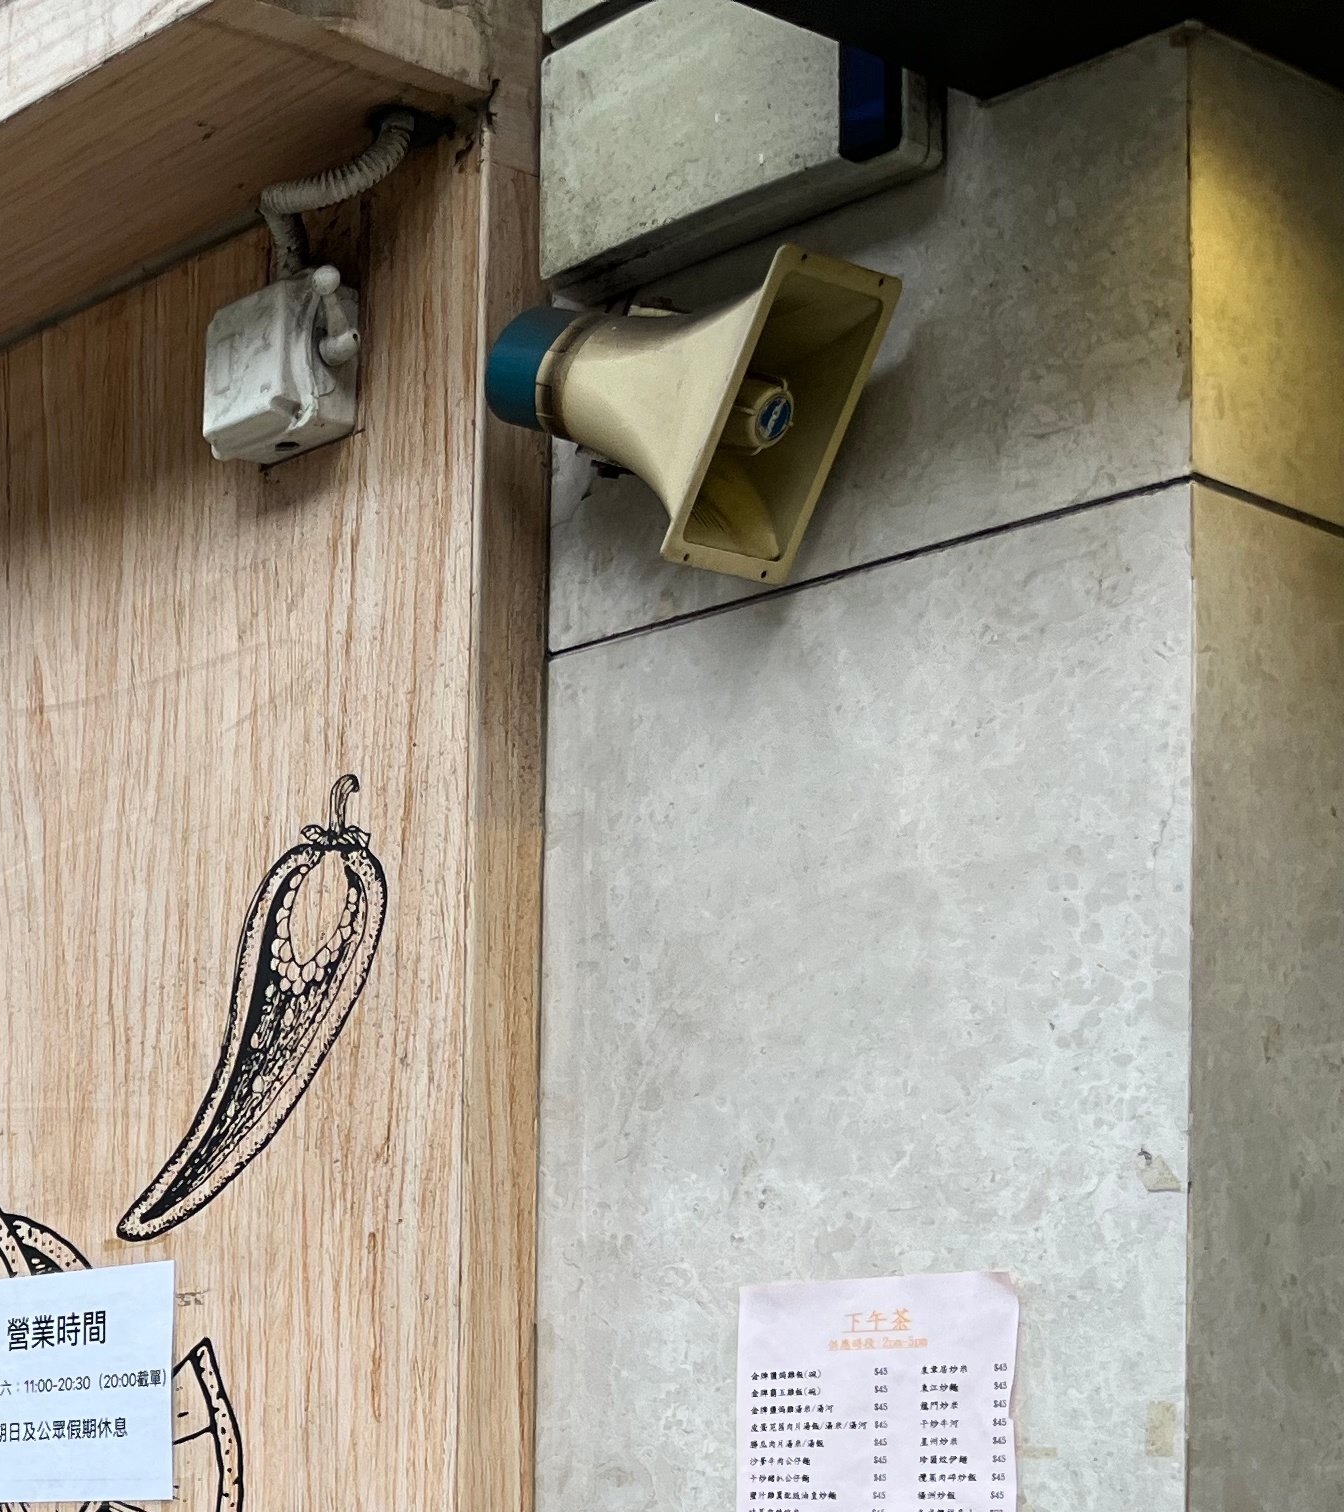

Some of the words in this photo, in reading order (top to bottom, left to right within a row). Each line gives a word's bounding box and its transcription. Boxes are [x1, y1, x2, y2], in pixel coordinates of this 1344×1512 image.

[844, 1307, 912, 1332] 下午茶
[7, 1310, 106, 1351] 營業時間
[991, 1473, 1005, 1481] $45
[872, 1491, 886, 1499] $45
[990, 1490, 1004, 1499] $45
